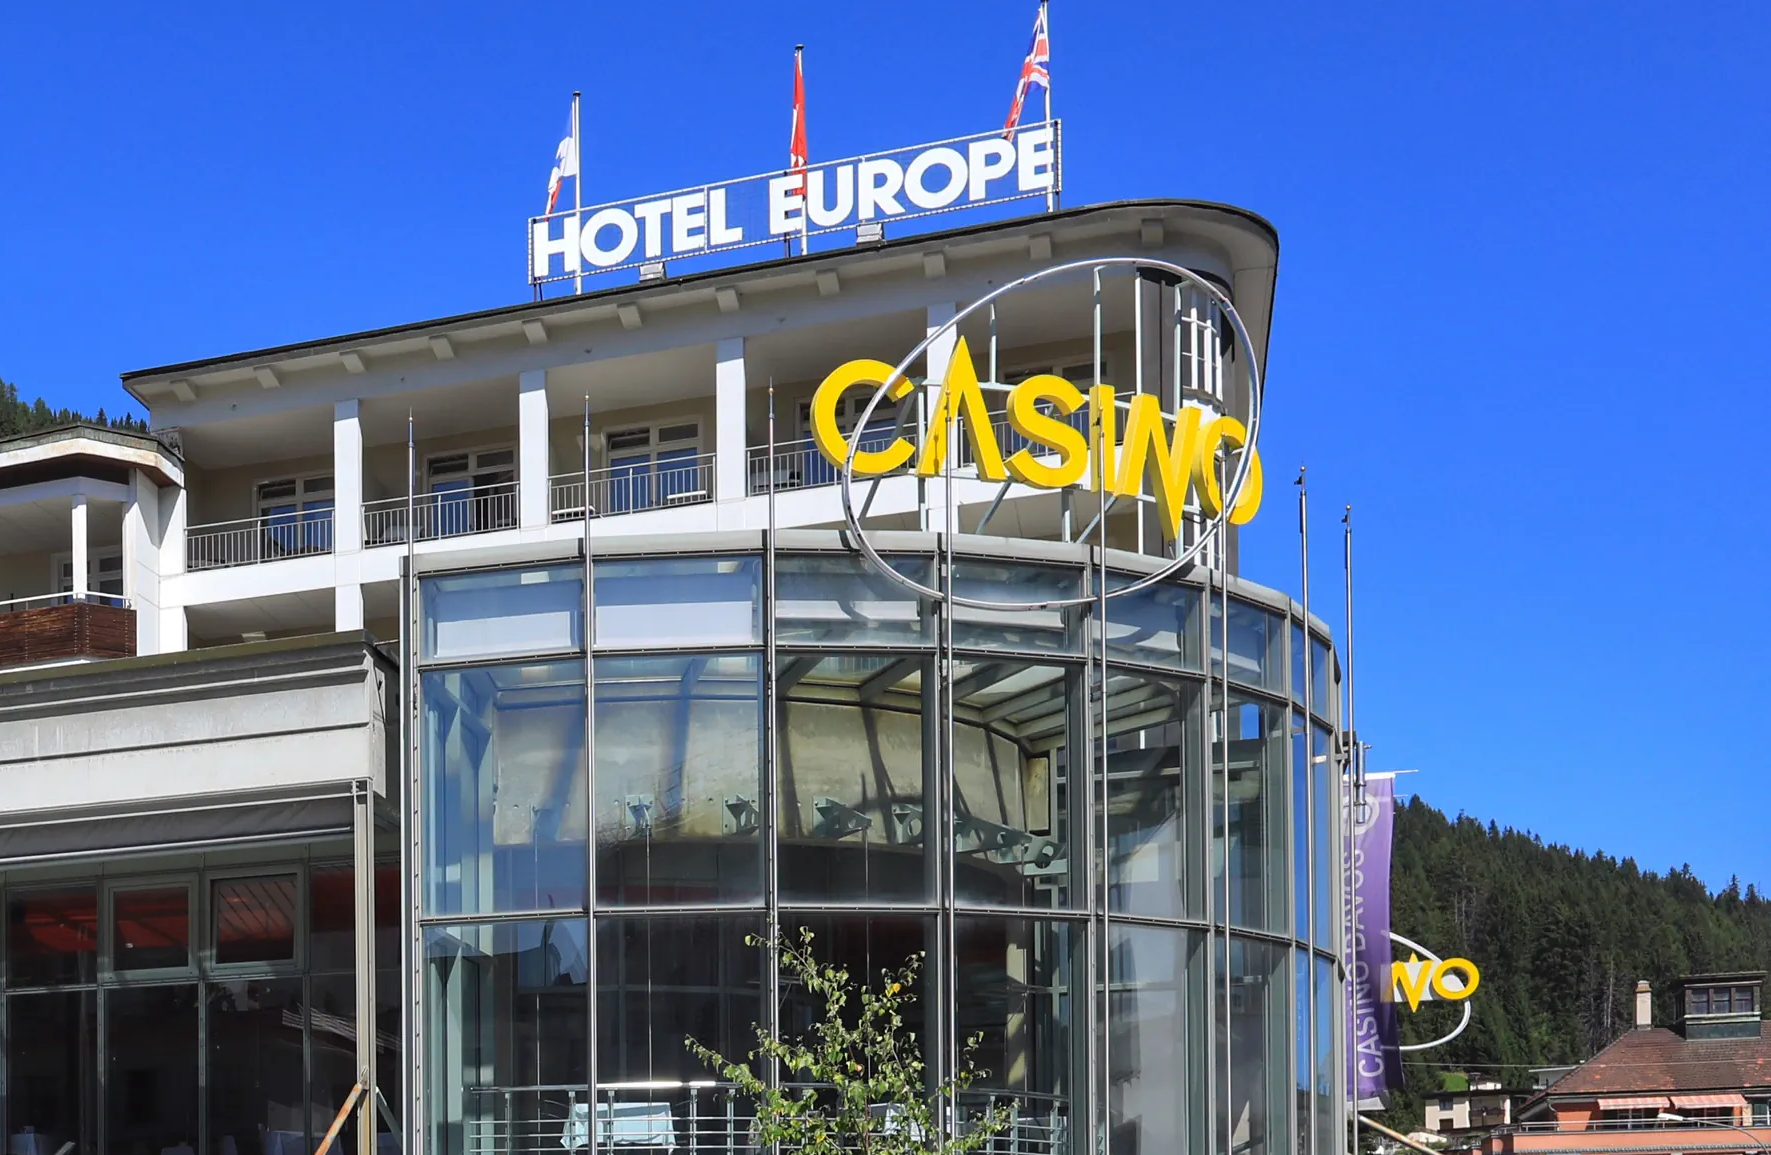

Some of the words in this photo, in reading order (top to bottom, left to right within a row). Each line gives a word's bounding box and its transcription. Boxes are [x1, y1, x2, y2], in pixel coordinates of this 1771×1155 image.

[533, 188, 743, 277] HOTEL
[769, 126, 1055, 234] EUROPE
[809, 335, 1263, 541] CASINO
[1344, 961, 1384, 1078] CASINO
